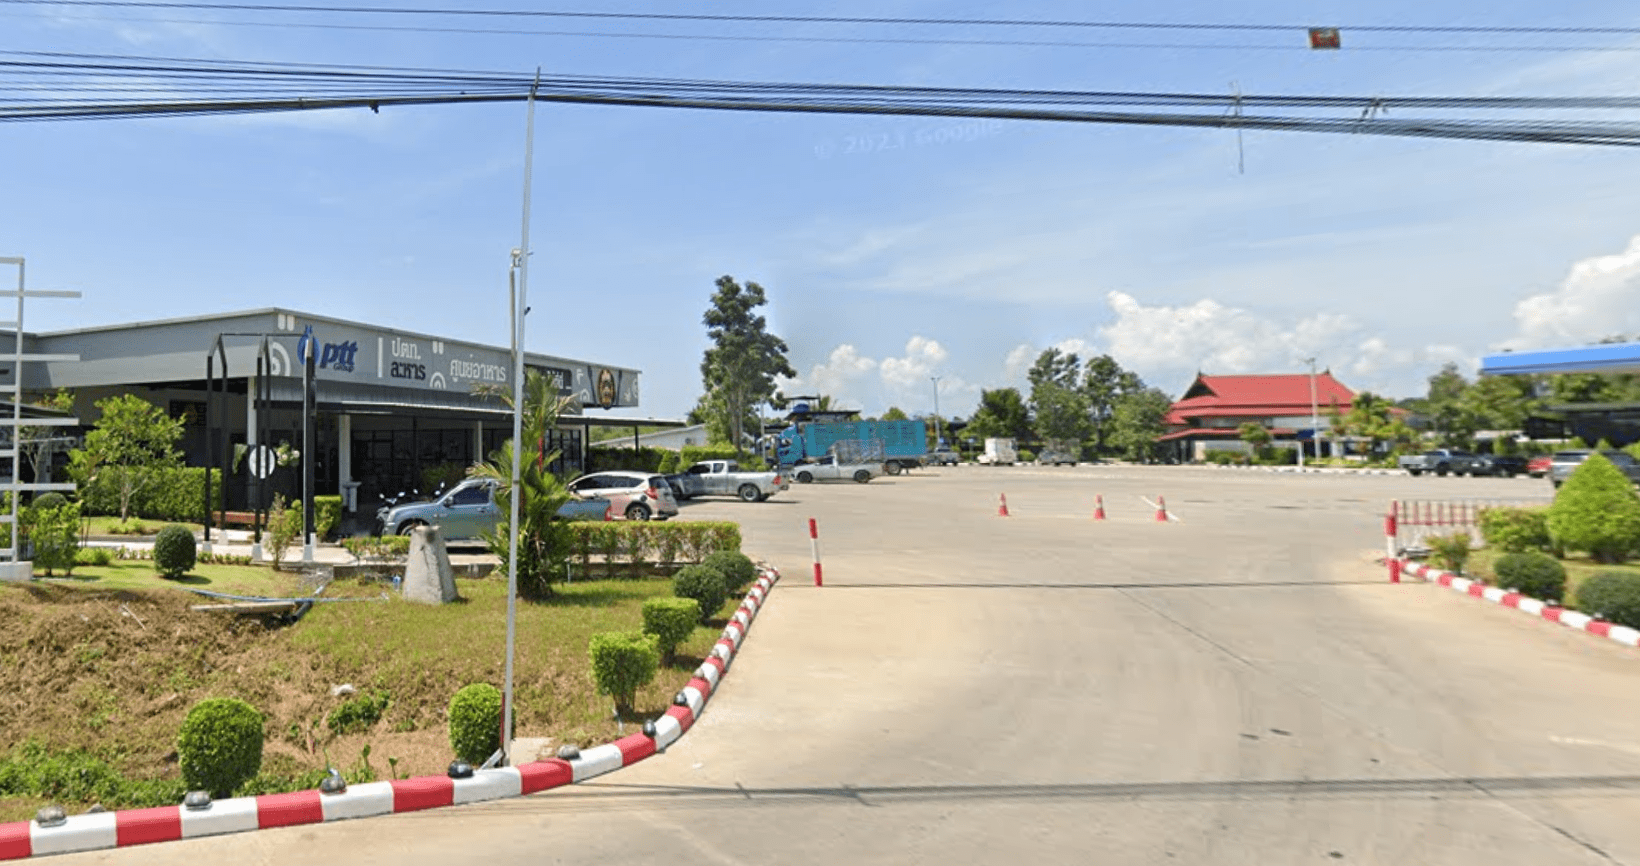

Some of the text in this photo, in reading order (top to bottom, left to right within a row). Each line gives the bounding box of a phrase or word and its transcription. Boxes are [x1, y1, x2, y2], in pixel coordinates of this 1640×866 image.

[319, 340, 358, 369] ptt
[450, 354, 507, 382] ศูนย์อาหาร
